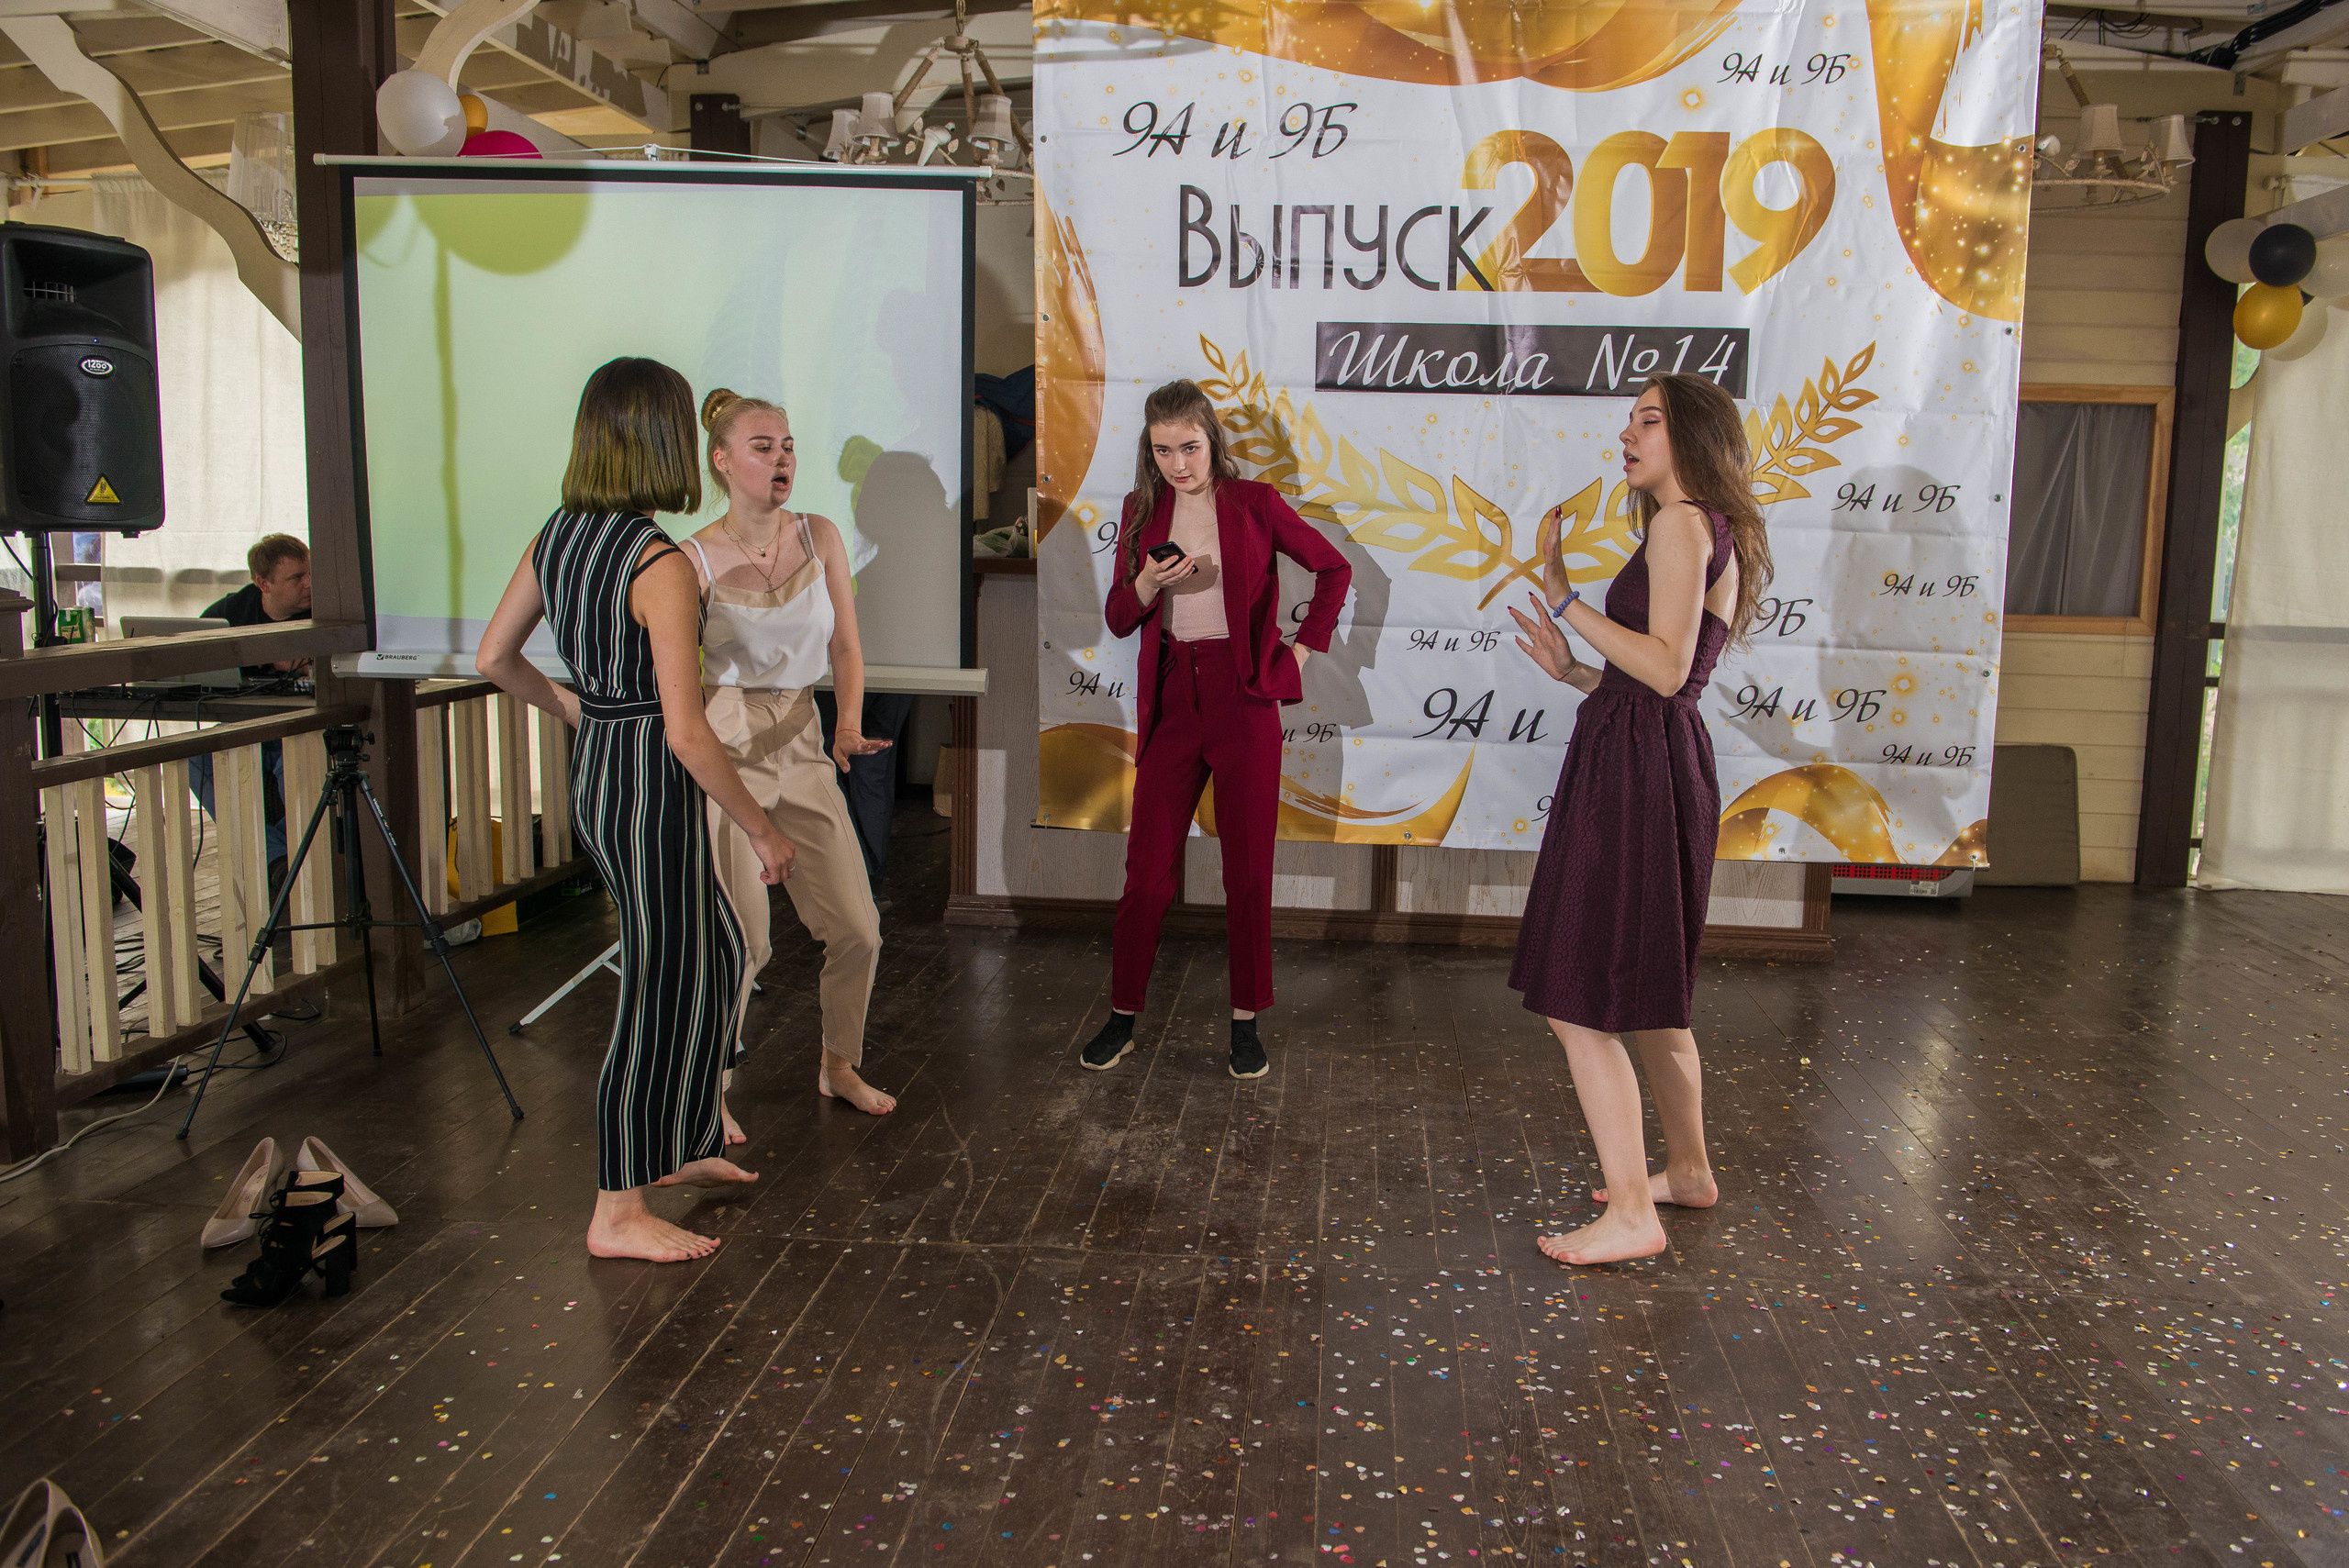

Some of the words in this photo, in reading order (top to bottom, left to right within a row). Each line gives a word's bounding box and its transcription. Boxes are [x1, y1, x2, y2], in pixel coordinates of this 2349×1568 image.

[1769, 64, 1792, 85] и
[1800, 53, 1852, 85] 9Б
[1210, 121, 1252, 160] и
[1268, 102, 1358, 160] 9Б
[1461, 127, 1836, 297] 2019
[1329, 330, 1554, 390] Школа
[1882, 493, 1904, 513] и
[1912, 484, 1961, 514] 9Б
[1092, 521, 1119, 555] 9
[1919, 582, 1936, 597] и
[1942, 574, 1979, 597] 9Б
[1443, 637, 1461, 652] и
[1466, 630, 1501, 652] 9Б
[1108, 681, 1126, 698] и
[1791, 698, 1819, 722] и
[1829, 688, 1887, 723] 9Б
[1303, 722, 1337, 743] 9Б
[1508, 708, 1549, 744] и
[1915, 751, 1933, 766] и
[1938, 745, 1976, 767] 9Б
